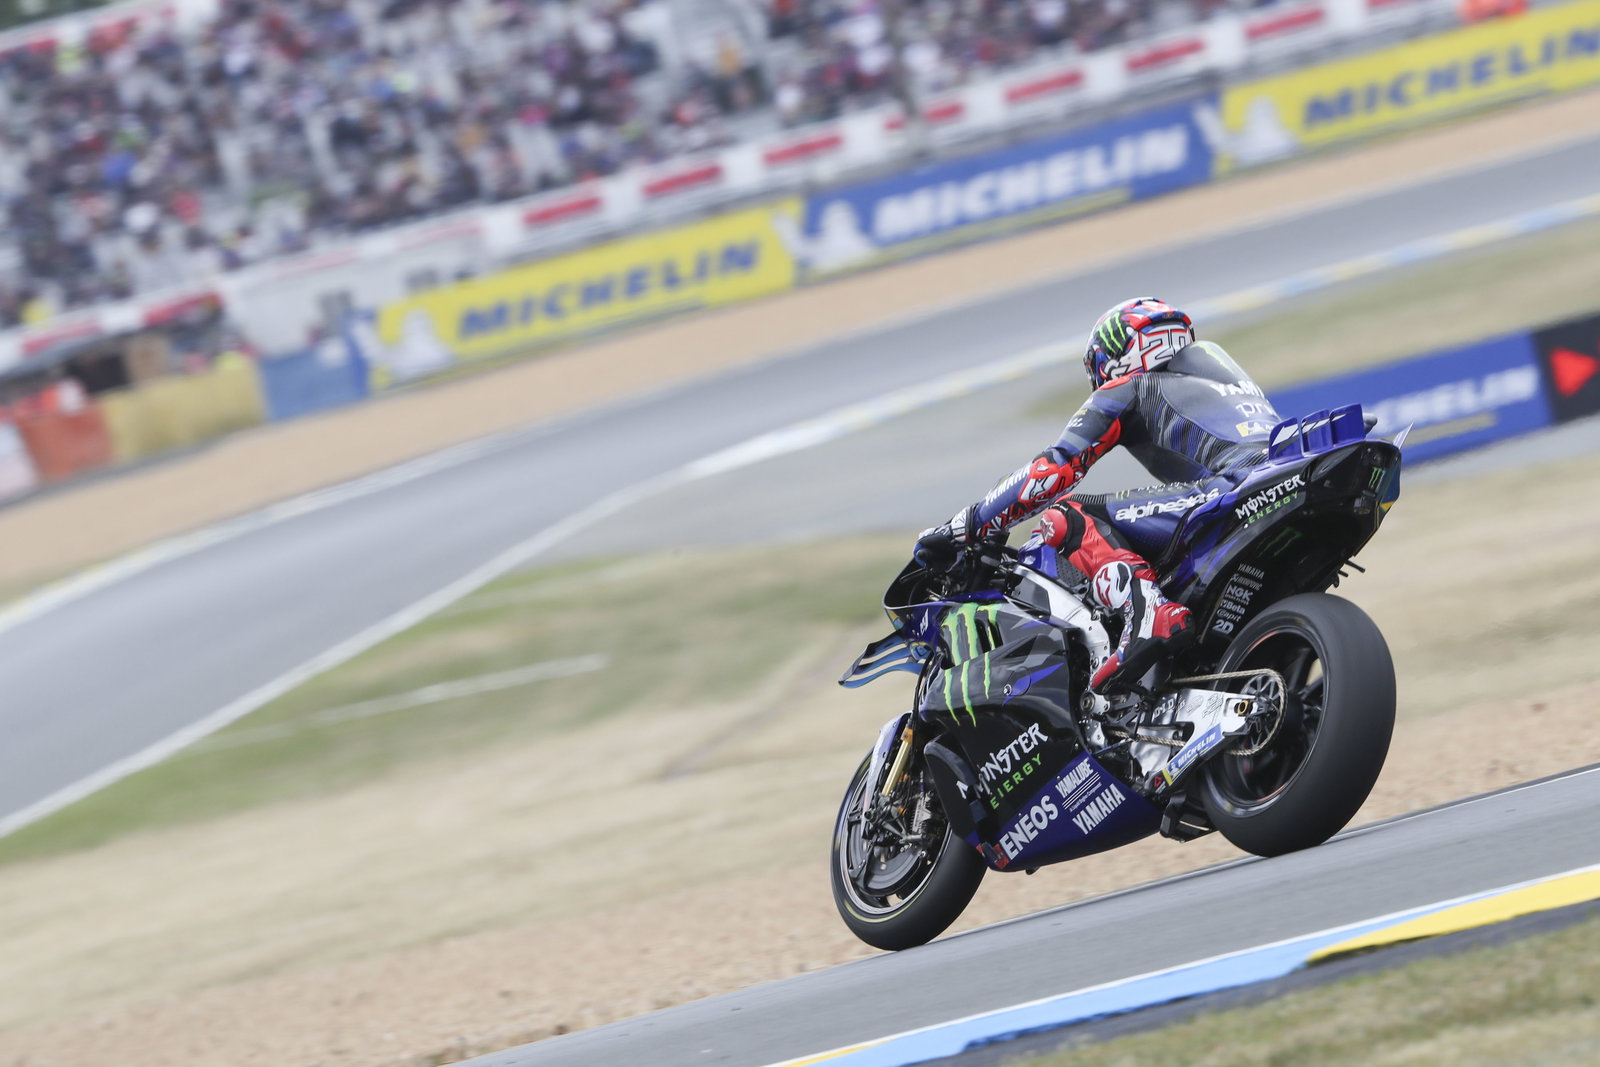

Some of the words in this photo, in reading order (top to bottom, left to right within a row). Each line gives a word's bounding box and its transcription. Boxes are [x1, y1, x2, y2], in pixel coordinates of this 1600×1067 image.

[873, 122, 1188, 240] MICHELIN
[458, 238, 761, 342] MICHELIN
[1114, 487, 1220, 524] alpinestas
[1235, 474, 1306, 519] MONSTER
[1248, 490, 1298, 524] ENERGY
[1238, 563, 1265, 580] YAMAHA
[1226, 584, 1254, 602] NGK
[1212, 619, 1234, 635] 2D
[1177, 732, 1217, 767] MICHELIN
[1055, 756, 1094, 799] YAMALUBE
[999, 795, 1059, 860] ENEOS
[1072, 783, 1126, 835] YAMAHA
